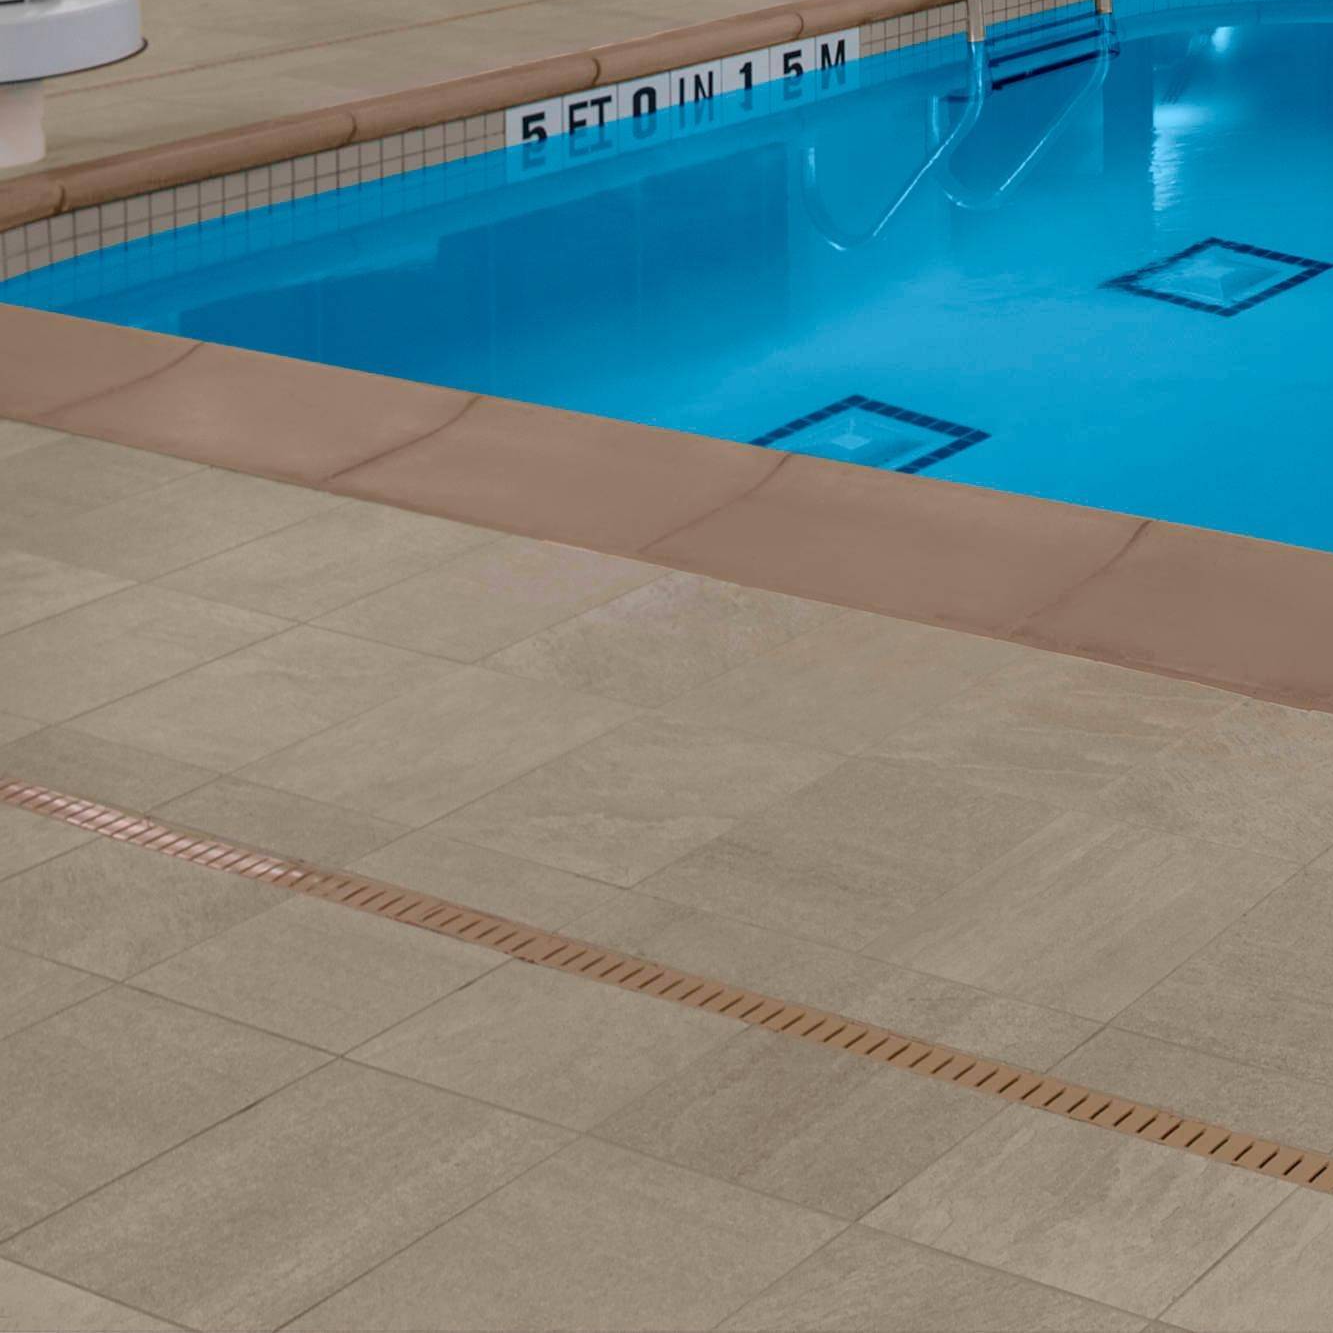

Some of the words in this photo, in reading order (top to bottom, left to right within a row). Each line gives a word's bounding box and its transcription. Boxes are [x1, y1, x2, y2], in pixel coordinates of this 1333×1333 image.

[521, 110, 548, 143] 5
[568, 95, 613, 135] FT
[632, 86, 658, 118] 0
[679, 70, 715, 106] IN
[738, 61, 755, 91] 1
[781, 49, 805, 79] 5
[820, 38, 847, 69] M
